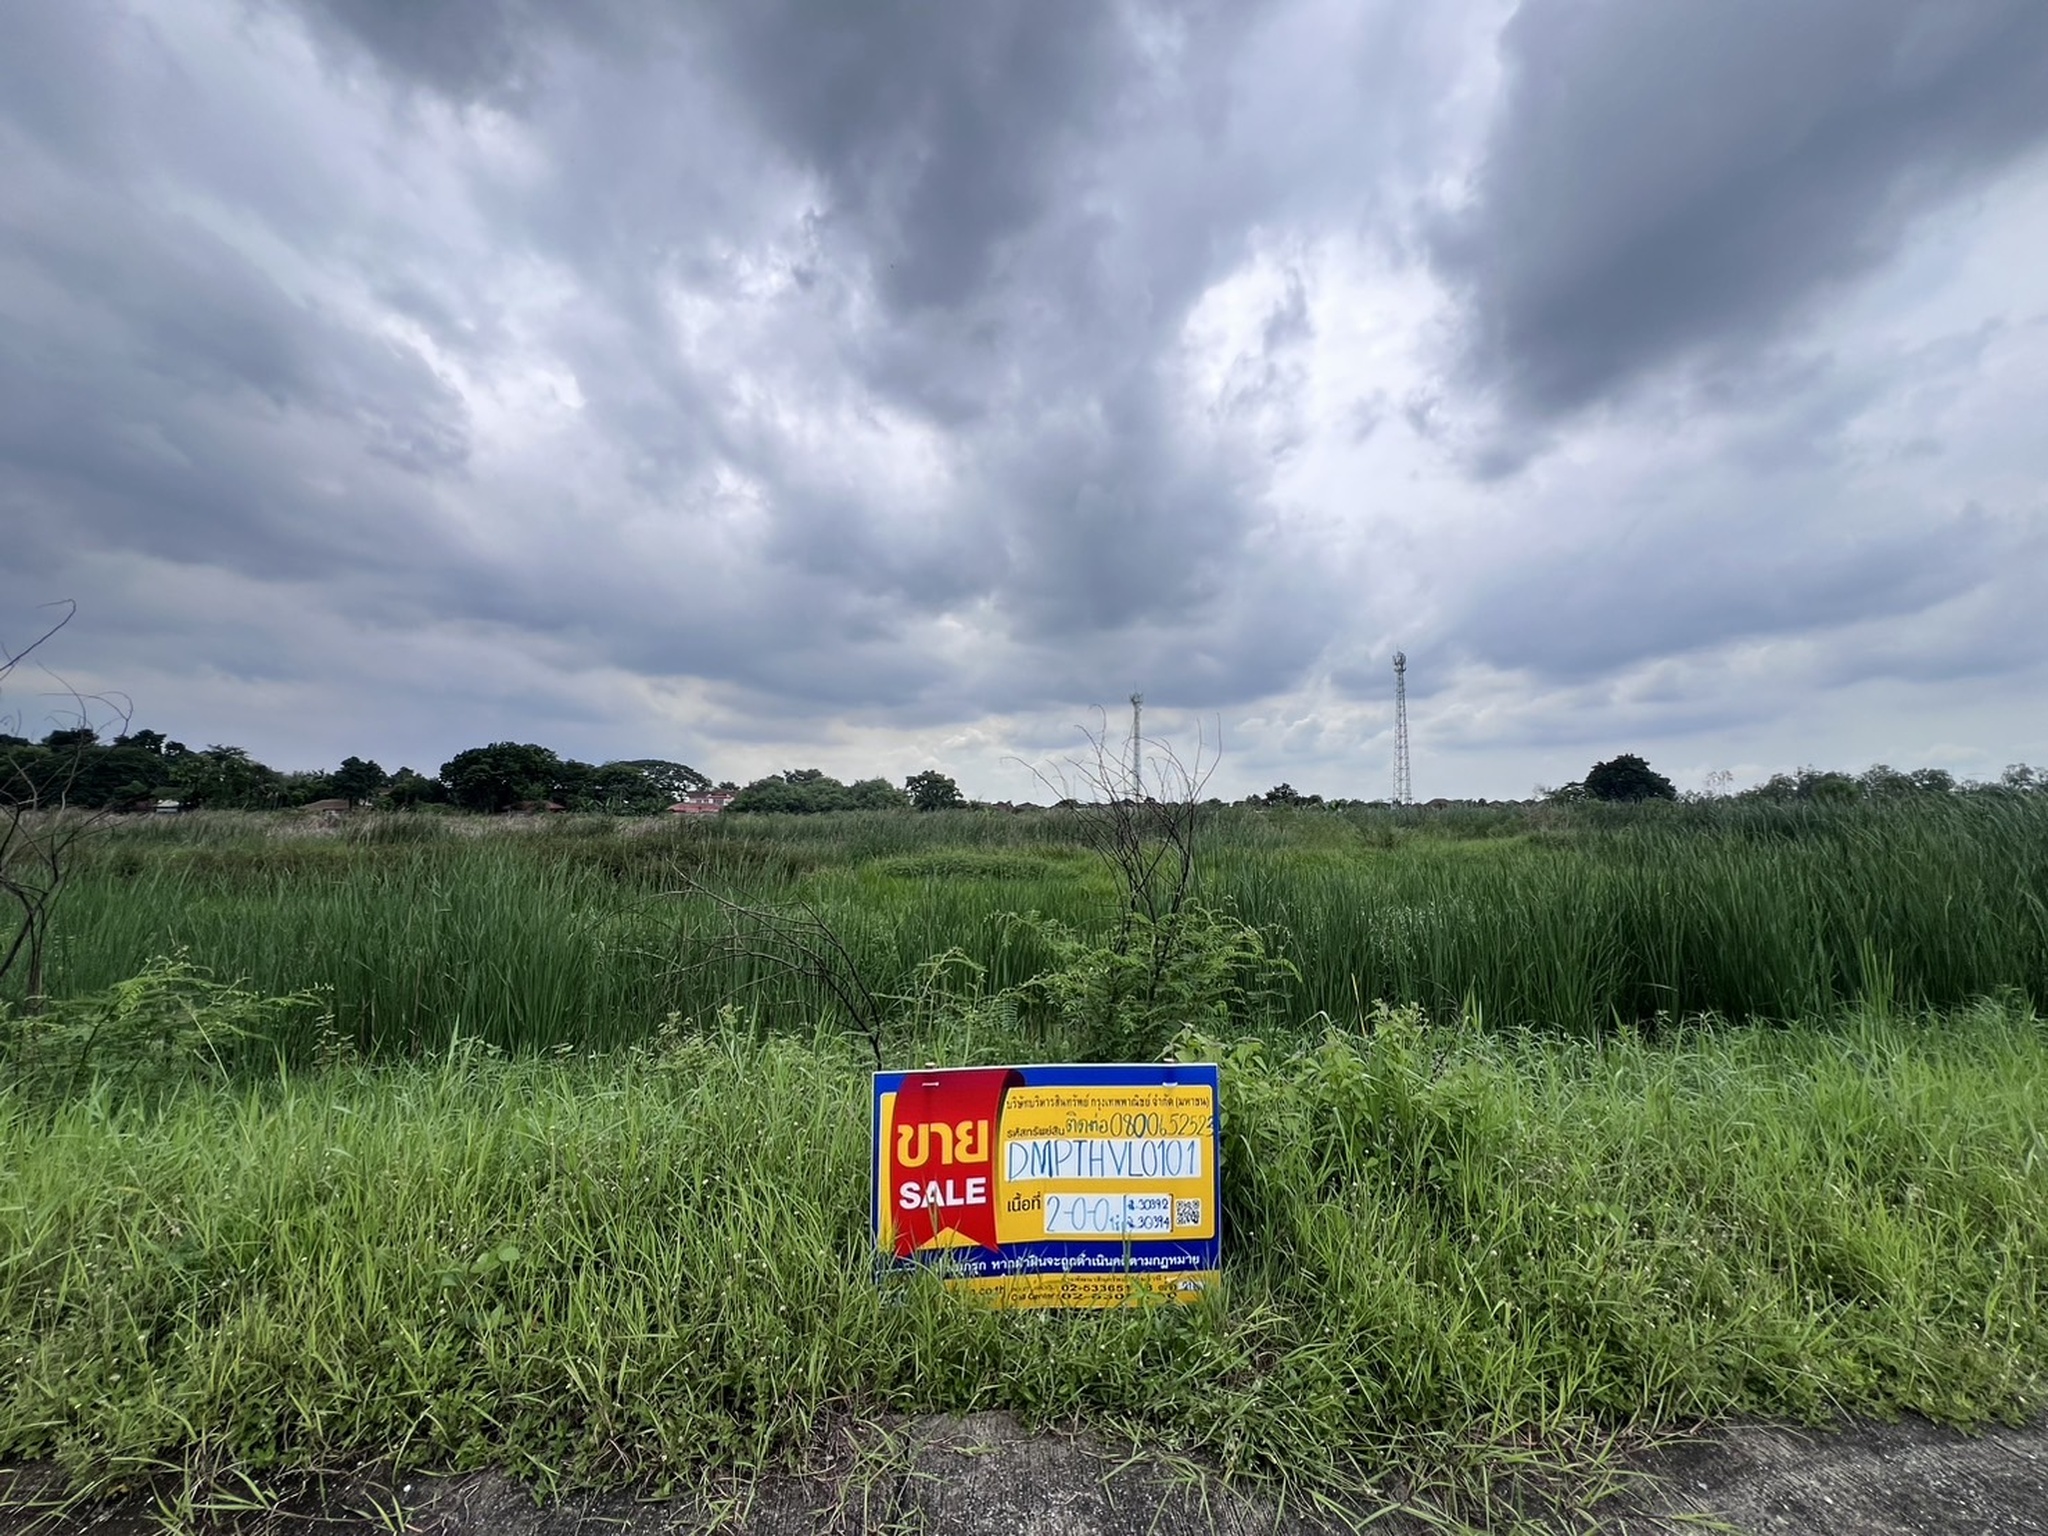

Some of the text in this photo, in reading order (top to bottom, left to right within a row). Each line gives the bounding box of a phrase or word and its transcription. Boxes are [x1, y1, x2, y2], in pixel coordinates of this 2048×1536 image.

[897, 1119, 989, 1168] ขาย
[1008, 1139, 1196, 1183] DMPTHVL0101
[899, 1177, 987, 1210] SALE
[1007, 1192, 1042, 1213] เนื้อที่
